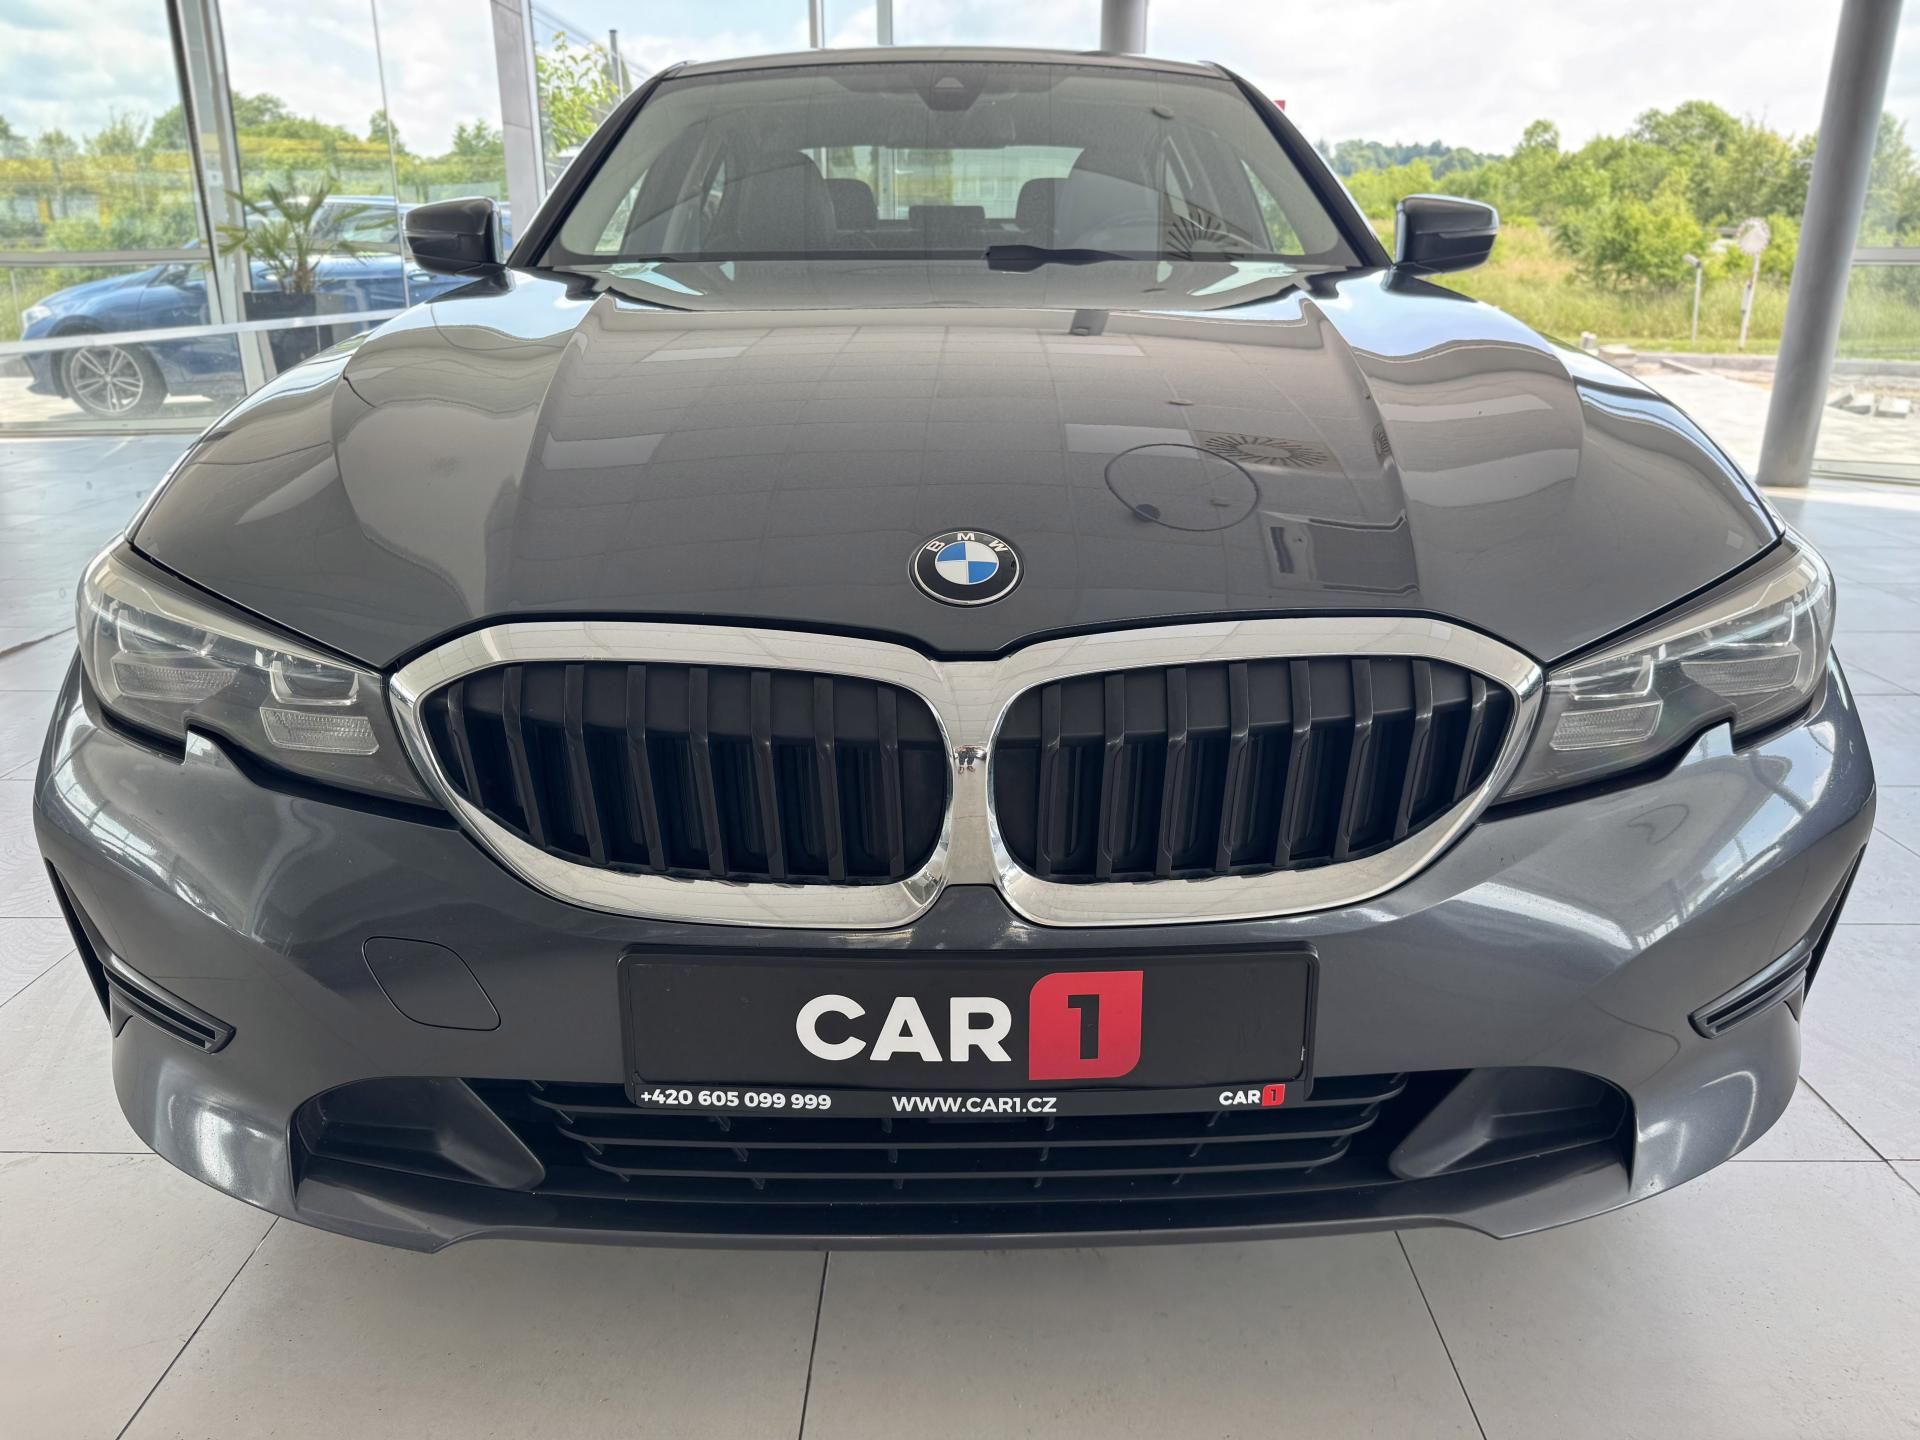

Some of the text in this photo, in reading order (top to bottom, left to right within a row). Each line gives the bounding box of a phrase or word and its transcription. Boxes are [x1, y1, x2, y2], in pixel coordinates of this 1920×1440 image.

[925, 532, 1009, 553] BMW
[795, 994, 1101, 1062] CAR 1
[640, 1089, 832, 1110] +420 605 099 999
[891, 1096, 1057, 1113] WWW.CAR1.CZ
[1218, 1089, 1261, 1106] CAR
